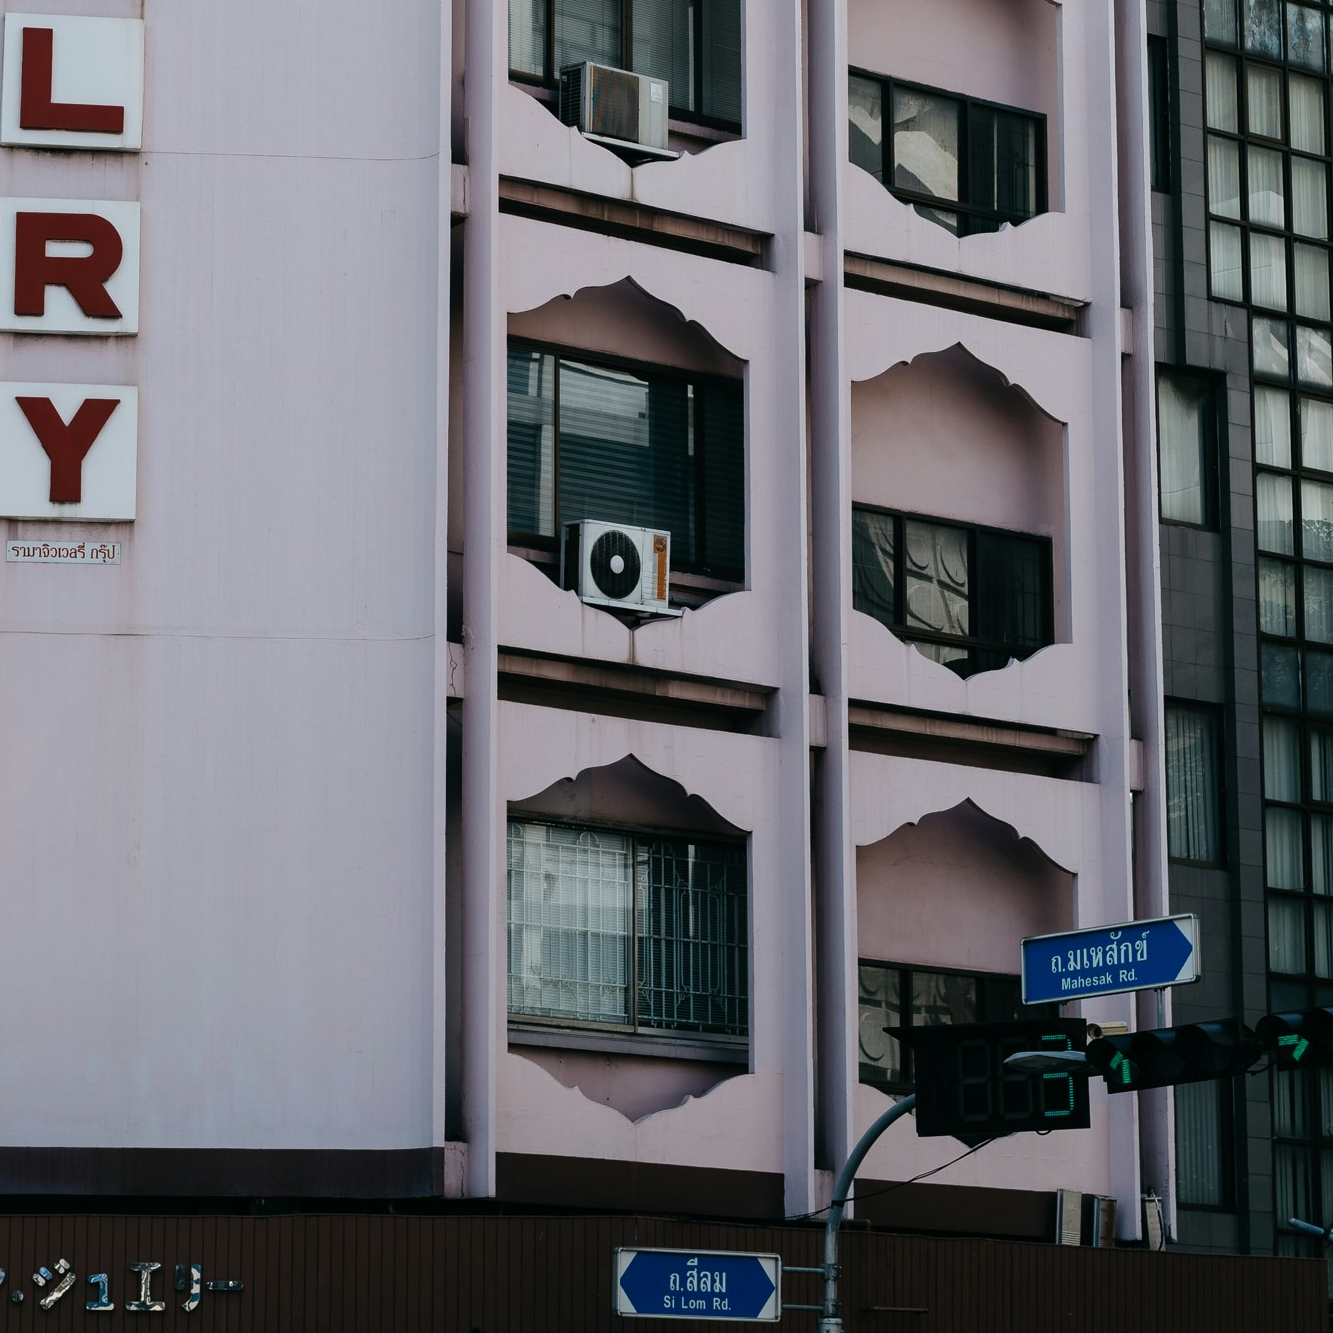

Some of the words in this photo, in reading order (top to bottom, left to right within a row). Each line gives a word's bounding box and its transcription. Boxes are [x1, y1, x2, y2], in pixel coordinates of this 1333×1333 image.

[90, 544, 116, 563] กรุ๊ป
[1051, 931, 1149, 973] ถ.มเหสักข์
[1061, 973, 1112, 990] Mahesak
[1119, 969, 1137, 982] Rd.
[669, 1257, 726, 1293] ถ.สีลม
[664, 1296, 675, 1308] Si
[682, 1297, 706, 1309] Lom
[713, 1298, 731, 1310] Rd.
